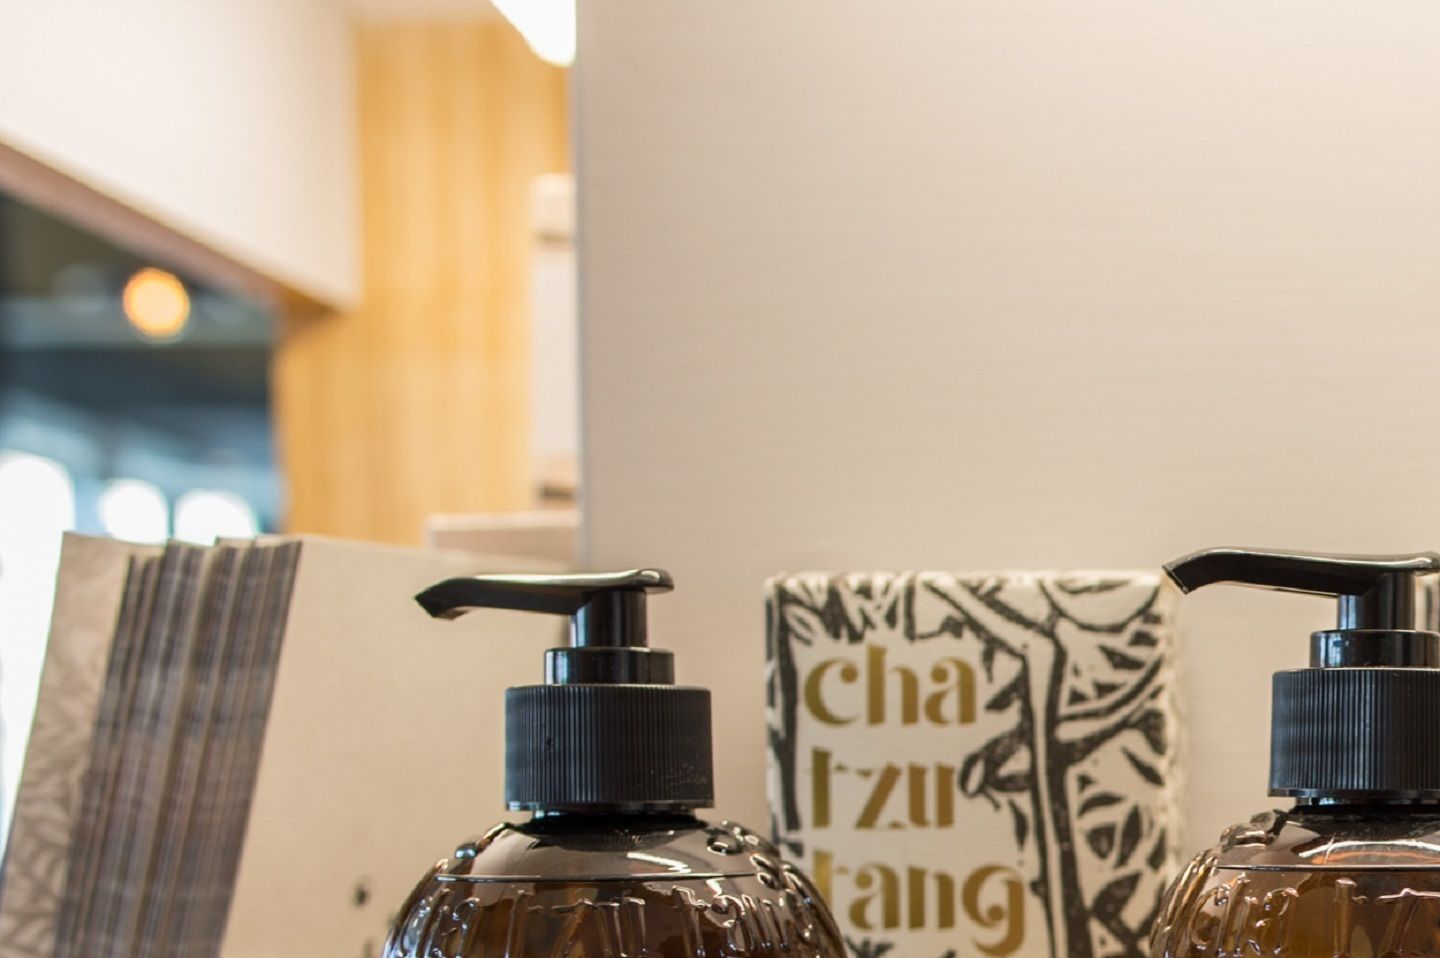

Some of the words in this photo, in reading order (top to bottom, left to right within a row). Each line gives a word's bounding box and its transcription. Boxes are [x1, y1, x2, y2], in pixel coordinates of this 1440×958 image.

[805, 643, 977, 728] cha
[808, 746, 956, 830] tzu
[812, 849, 1025, 958] tang
